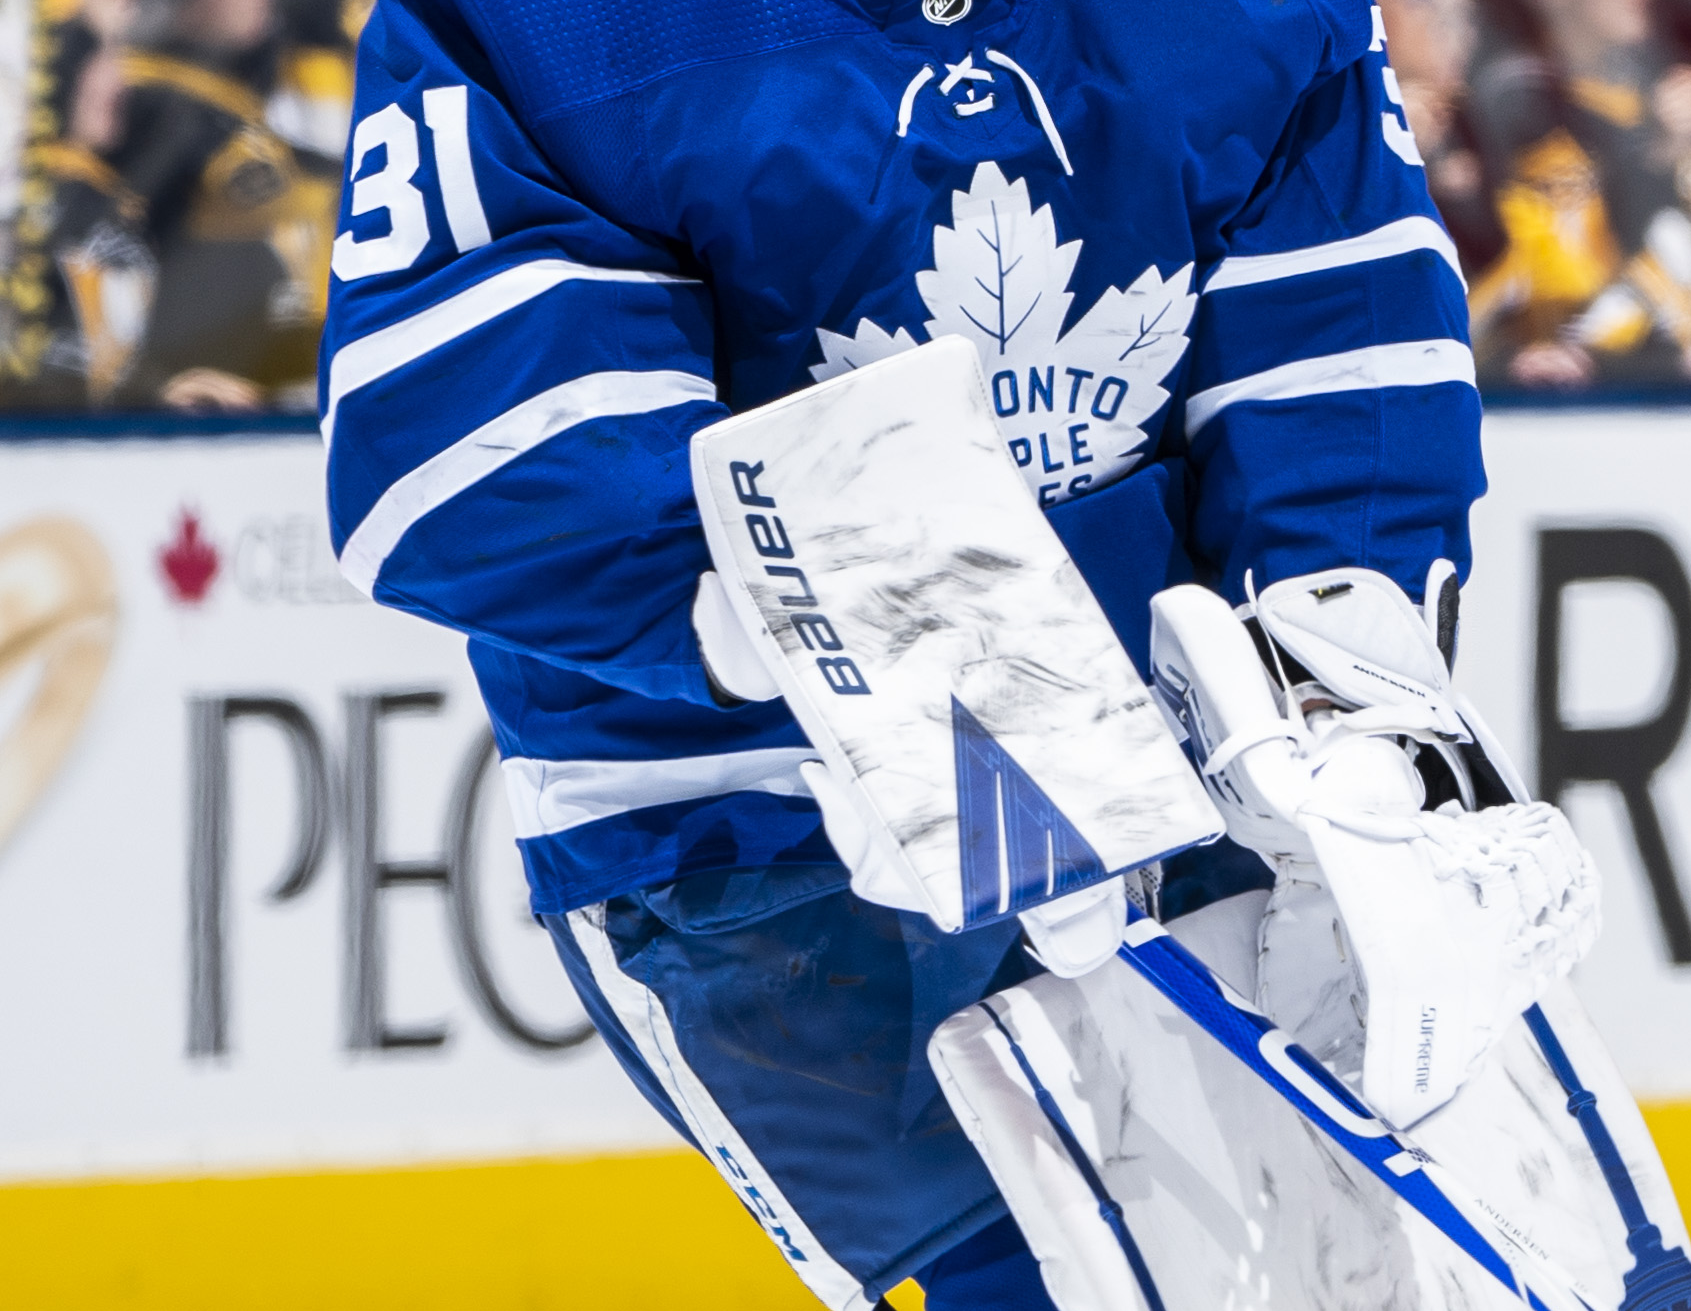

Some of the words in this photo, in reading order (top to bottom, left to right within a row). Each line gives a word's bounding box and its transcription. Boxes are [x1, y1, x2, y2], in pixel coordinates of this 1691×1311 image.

[331, 85, 492, 282] 31
[992, 365, 1129, 421] ONTO
[1008, 423, 1093, 474] PLE
[730, 460, 873, 695] BAUER
[715, 1143, 809, 1262] CCM
[1474, 1198, 1549, 1260] ANDERSEN
